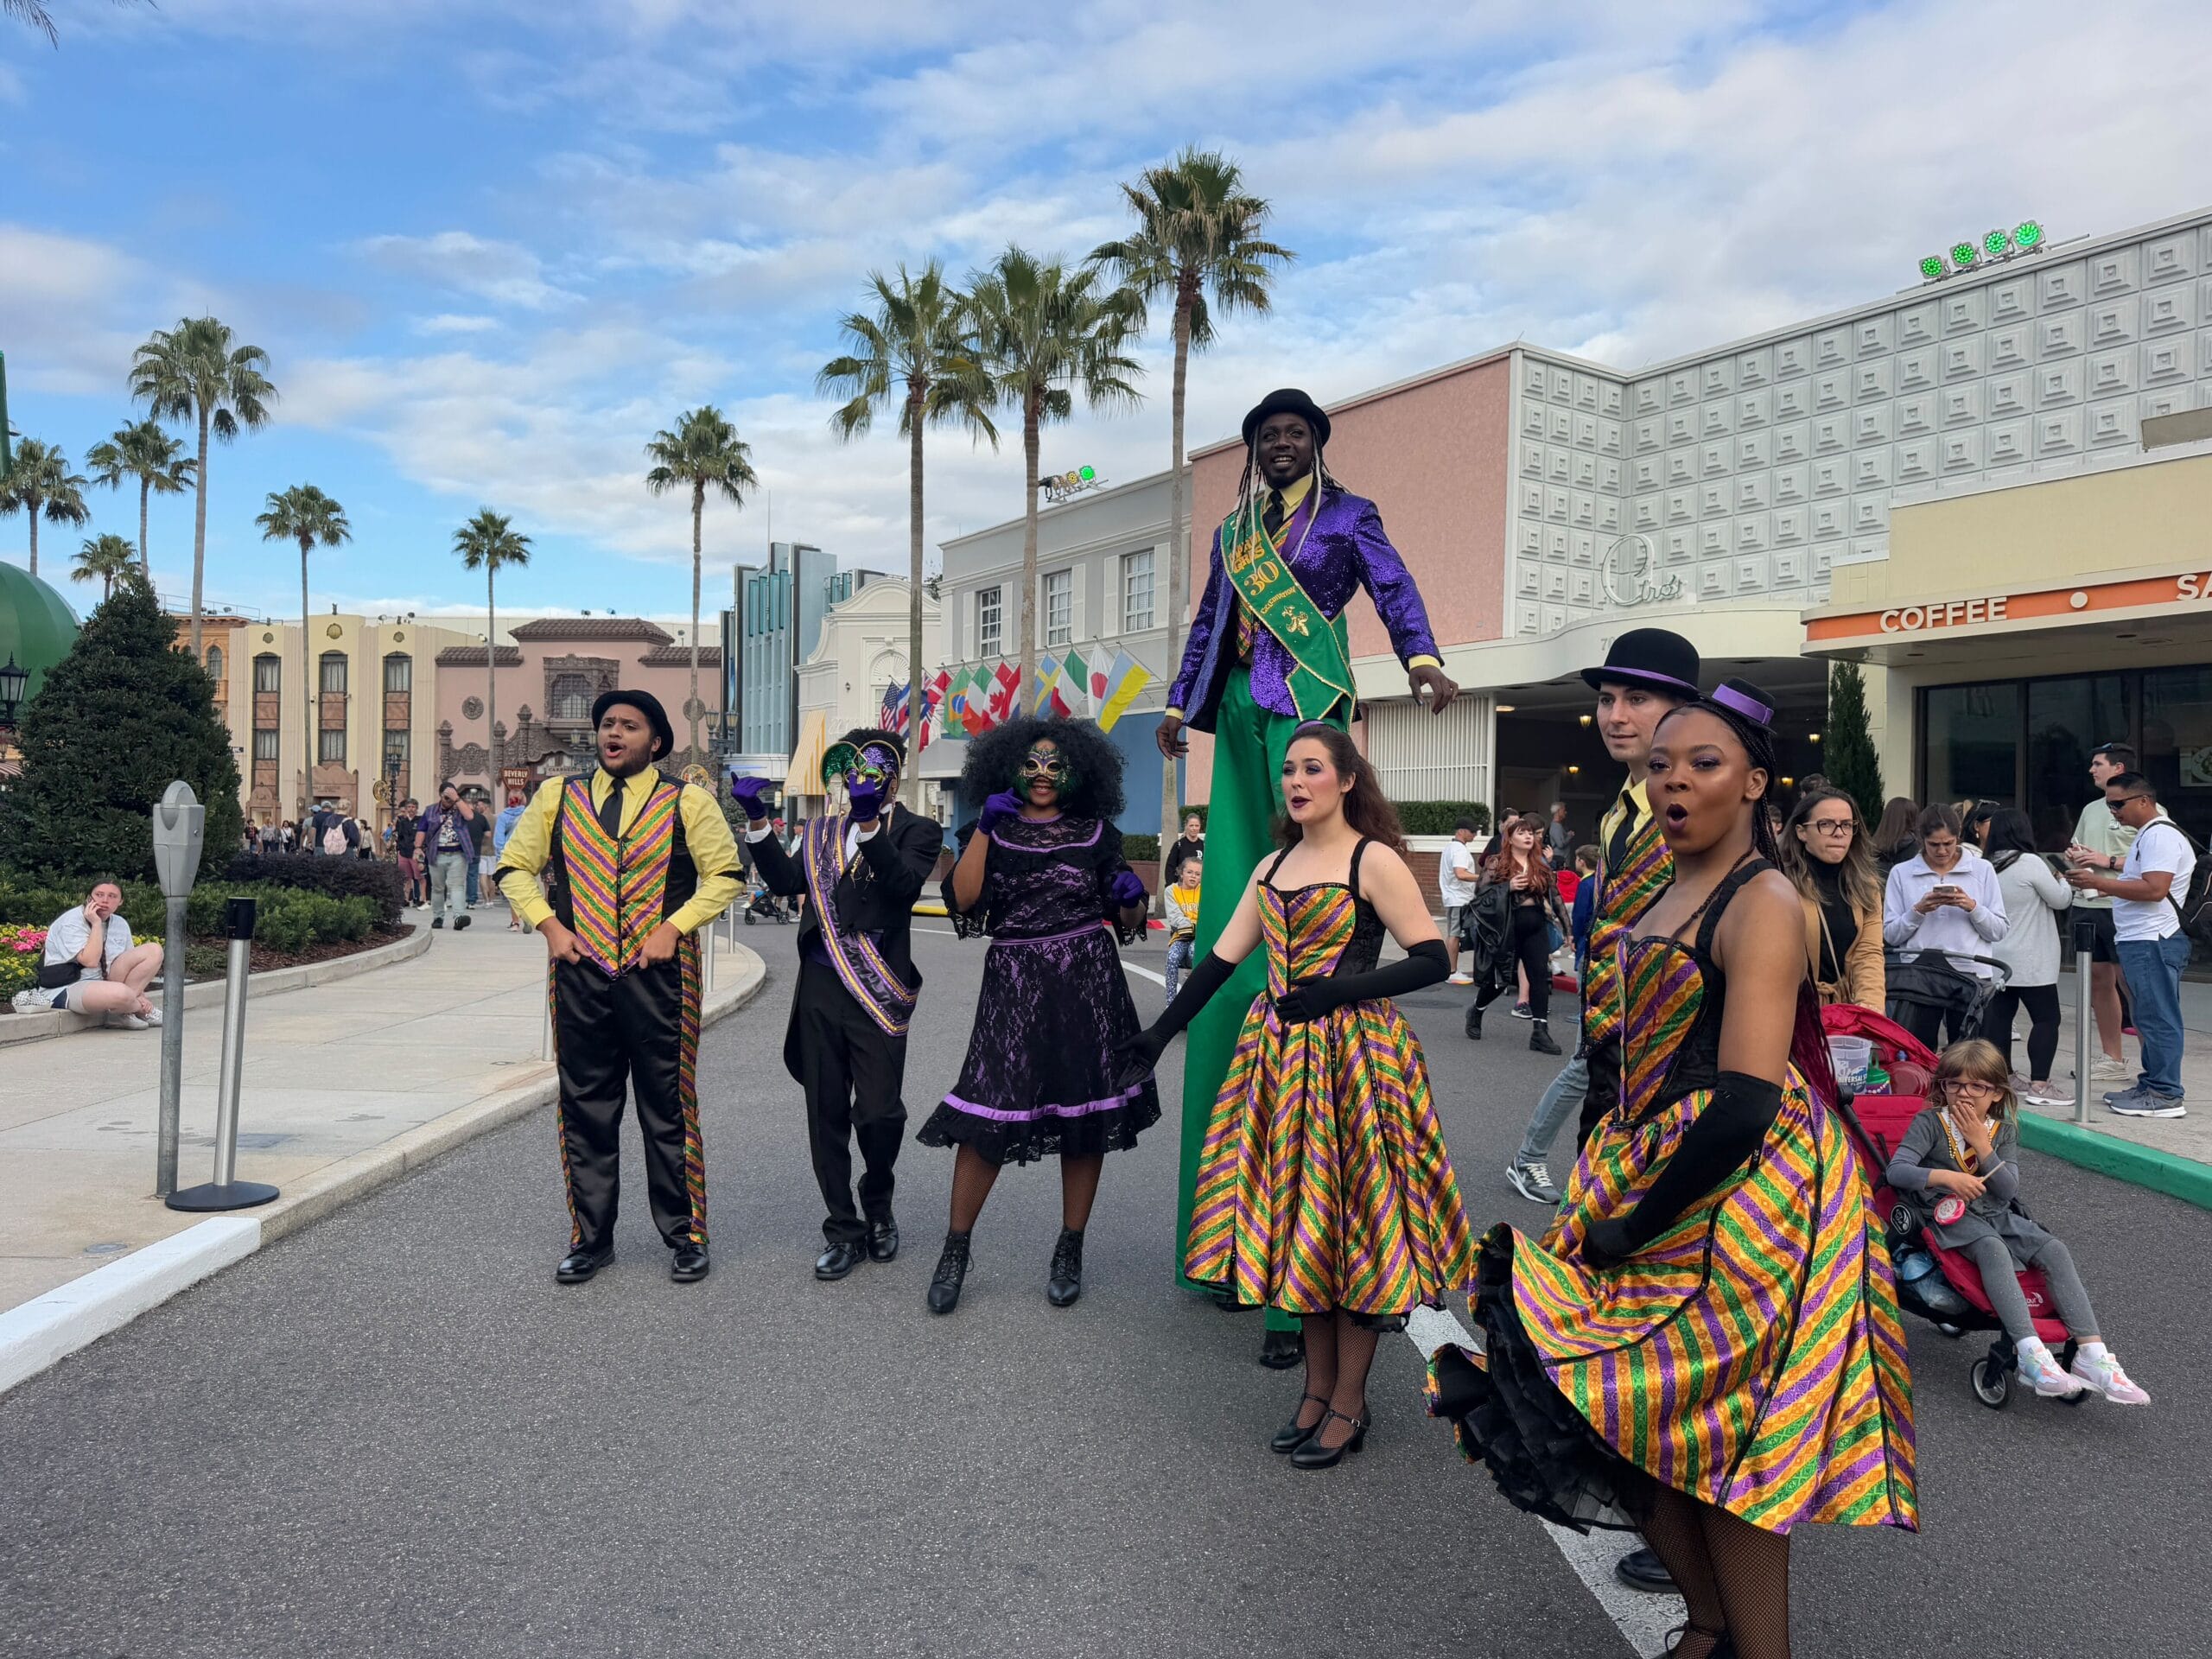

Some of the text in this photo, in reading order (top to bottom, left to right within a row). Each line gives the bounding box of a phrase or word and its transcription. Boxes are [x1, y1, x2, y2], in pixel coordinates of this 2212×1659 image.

[1243, 560, 1280, 596] 30
[1260, 586, 1297, 614] CELEBRATION
[1879, 596, 2008, 633] COFFEE
[504, 770, 528, 779] BEVERLY
[1838, 1075, 1863, 1084] NIVERSAL
